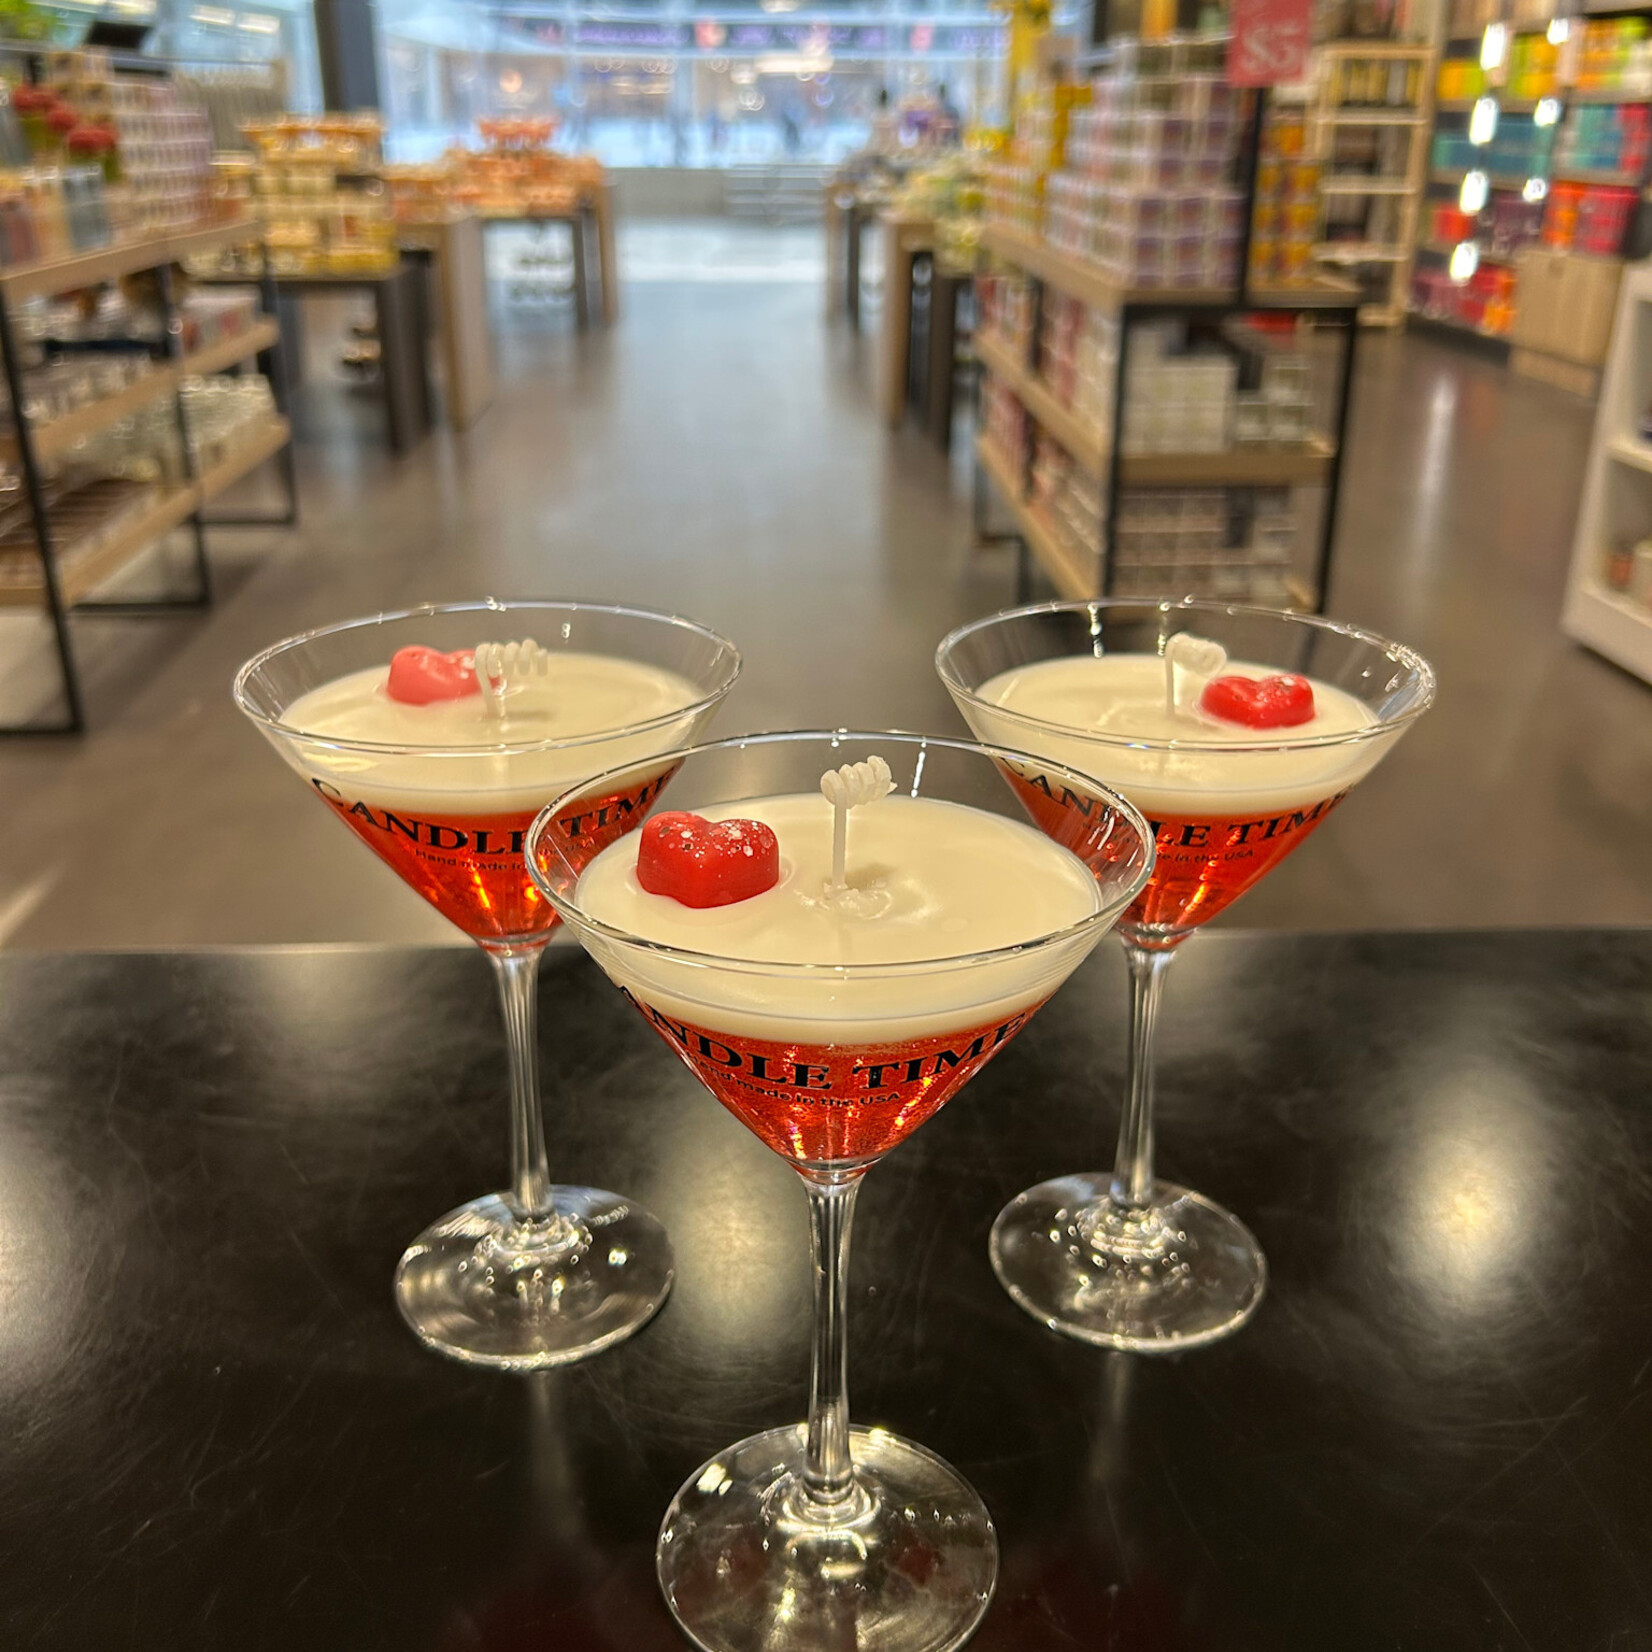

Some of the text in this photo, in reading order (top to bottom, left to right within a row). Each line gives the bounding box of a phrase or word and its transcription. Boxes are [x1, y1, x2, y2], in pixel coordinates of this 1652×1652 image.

[852, 1012, 1025, 1090] TIME
[736, 1078, 793, 1102] made
[859, 1090, 901, 1106] USA
